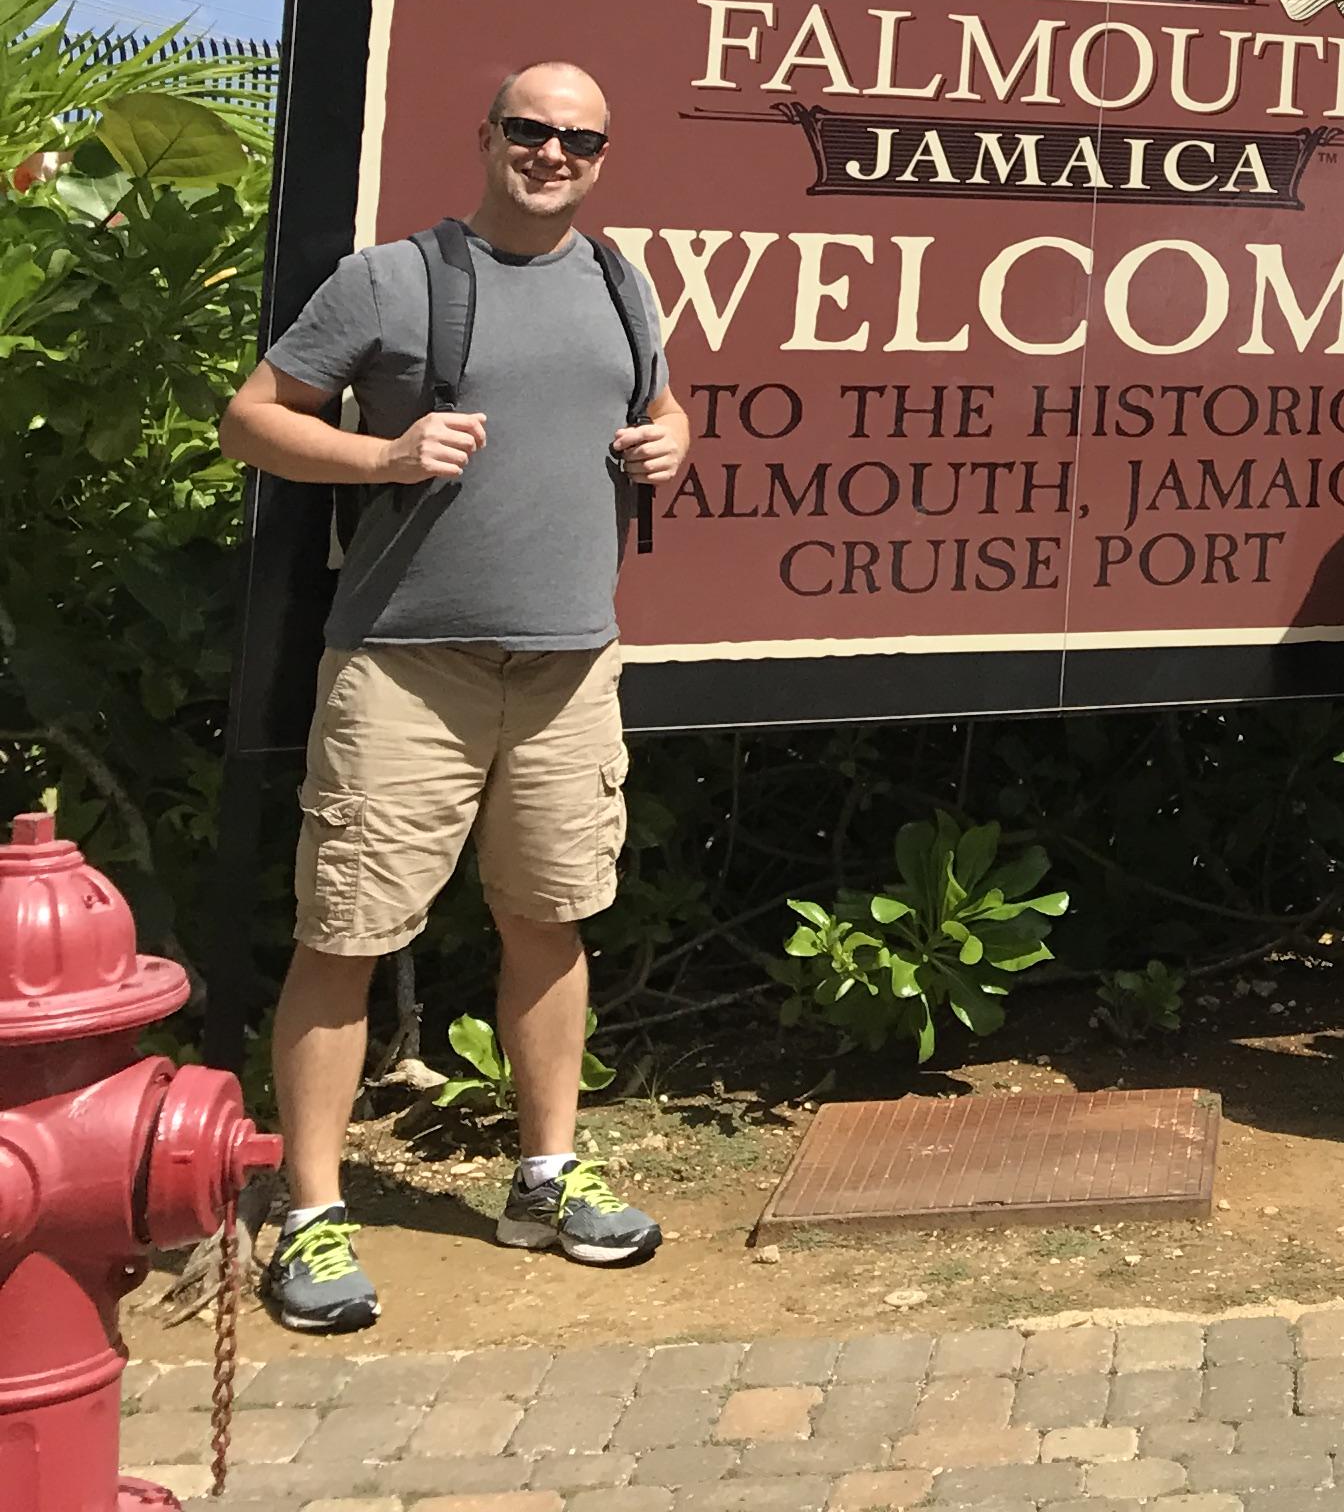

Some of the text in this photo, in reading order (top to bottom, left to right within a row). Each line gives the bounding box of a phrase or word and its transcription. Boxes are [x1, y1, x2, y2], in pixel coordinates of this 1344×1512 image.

[844, 127, 1279, 196] JAMAICA
[690, 383, 803, 439] TO
[840, 385, 995, 438] THE
[655, 460, 1090, 521] ALMOUTH,
[779, 532, 1286, 596] CRUISE PORT
